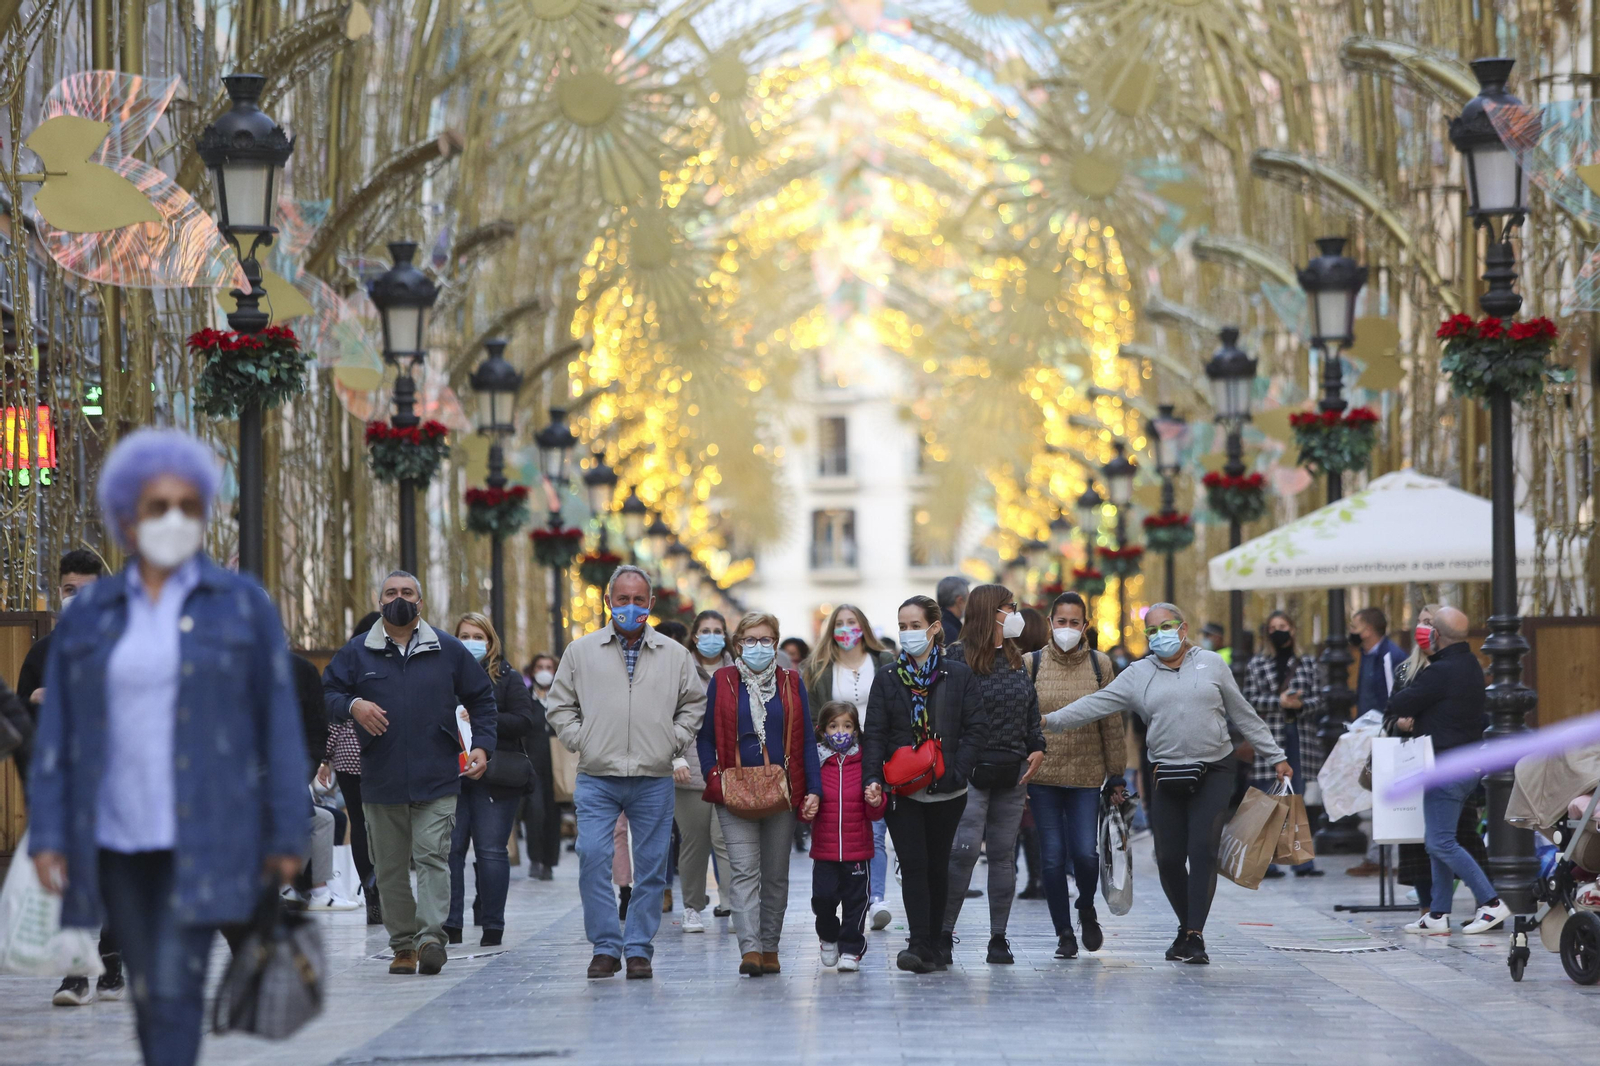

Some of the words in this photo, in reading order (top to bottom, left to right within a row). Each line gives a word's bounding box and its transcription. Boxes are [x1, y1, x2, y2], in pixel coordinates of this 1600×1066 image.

[1265, 567, 1291, 577] Este
[1295, 565, 1338, 577] parasol
[1342, 561, 1406, 574] contribuye
[1411, 561, 1419, 570] a
[1422, 560, 1445, 571] que
[1449, 557, 1492, 571] respire
